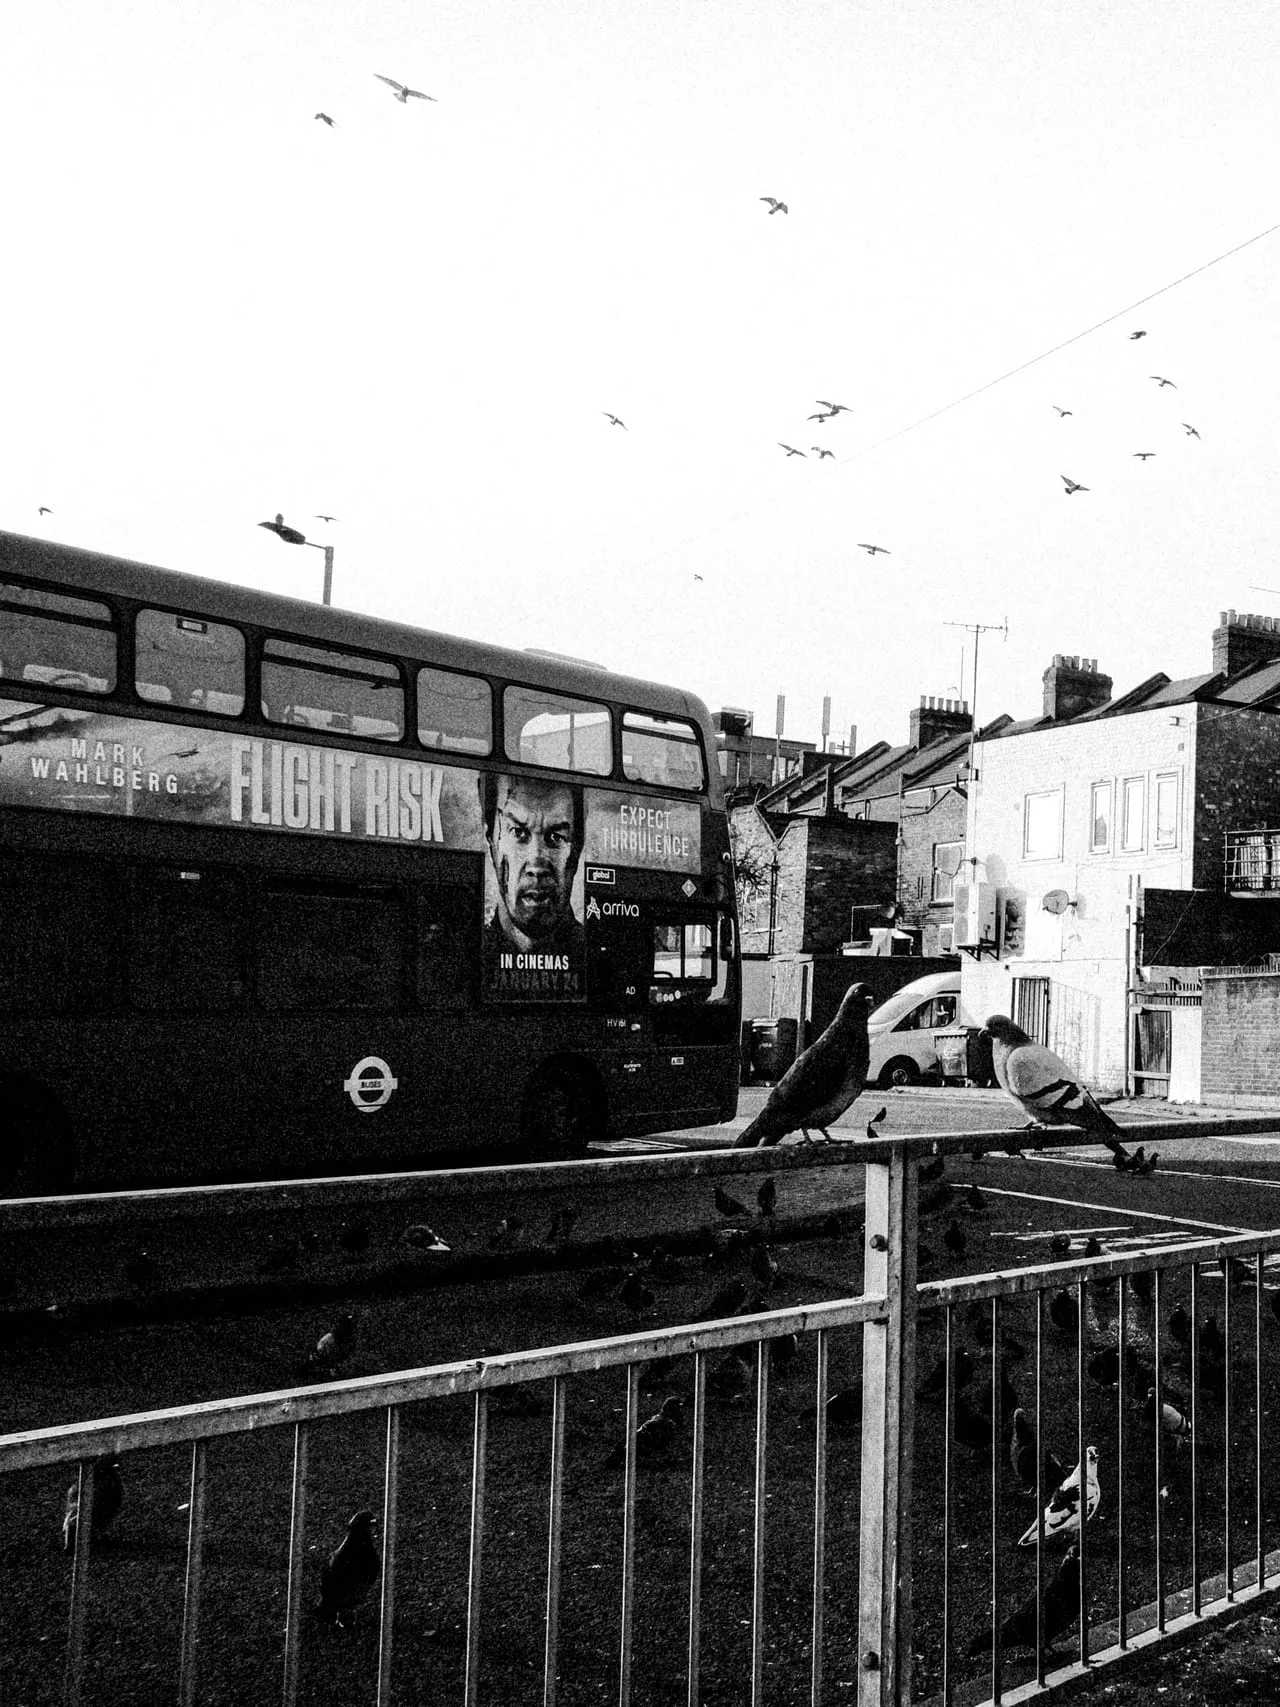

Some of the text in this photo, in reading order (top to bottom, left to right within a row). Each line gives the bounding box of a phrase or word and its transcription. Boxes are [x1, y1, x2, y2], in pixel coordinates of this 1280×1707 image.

[71, 737, 144, 767] MARK
[31, 757, 178, 794] WAHLBERG
[231, 739, 444, 843] FLIGHT RISK
[620, 804, 672, 830] EXPECT
[601, 827, 689, 857] TURBULENCE
[602, 900, 640, 917] arriva
[500, 953, 569, 970] IN CINEMAS
[625, 986, 636, 995] AD
